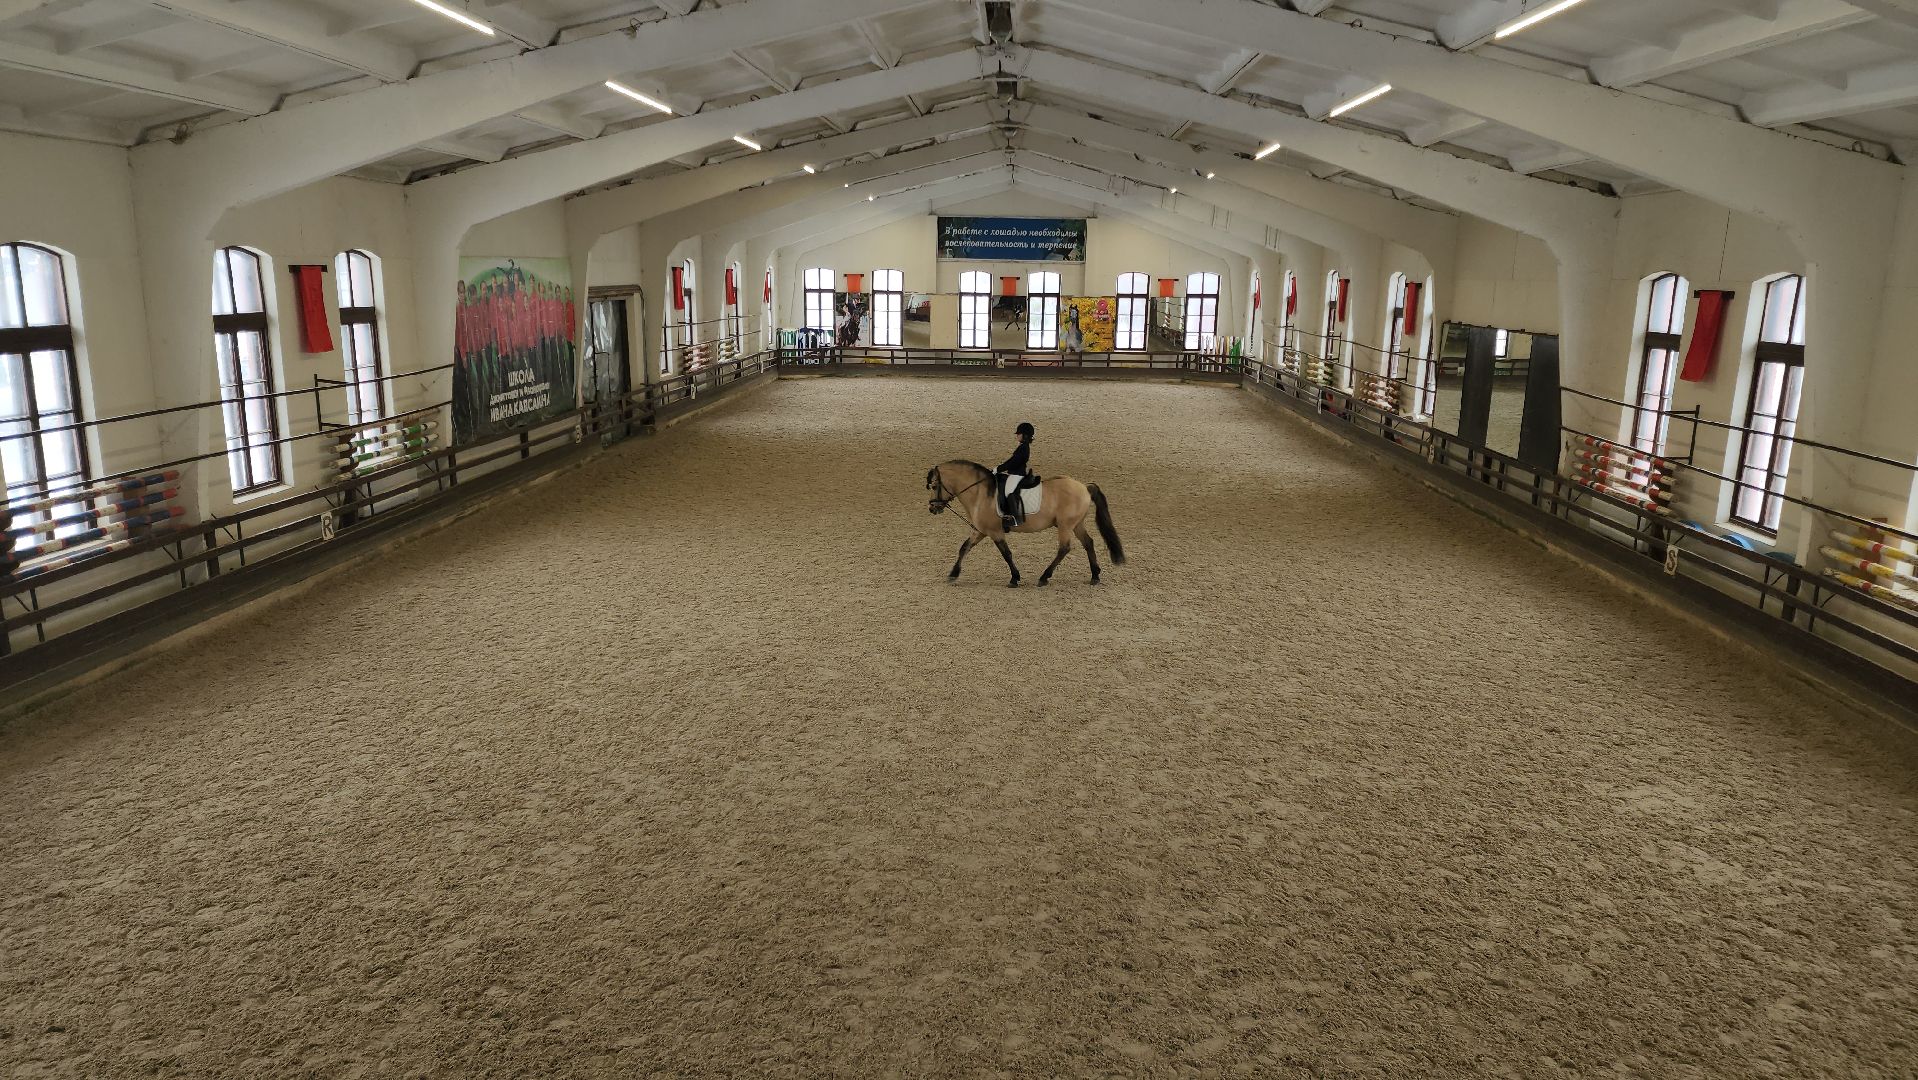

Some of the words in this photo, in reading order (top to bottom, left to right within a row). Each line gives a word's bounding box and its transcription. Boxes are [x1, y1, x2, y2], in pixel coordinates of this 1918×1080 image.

[945, 227, 951, 235] В
[952, 227, 983, 237] работе
[990, 227, 1028, 237] лошадью
[1029, 228, 1077, 238] необходимы
[945, 240, 1029, 249] последовательность
[1038, 242, 1078, 251] терпение
[508, 368, 535, 387] ШКОЛА
[323, 515, 333, 537] R
[1667, 549, 1676, 571] S
